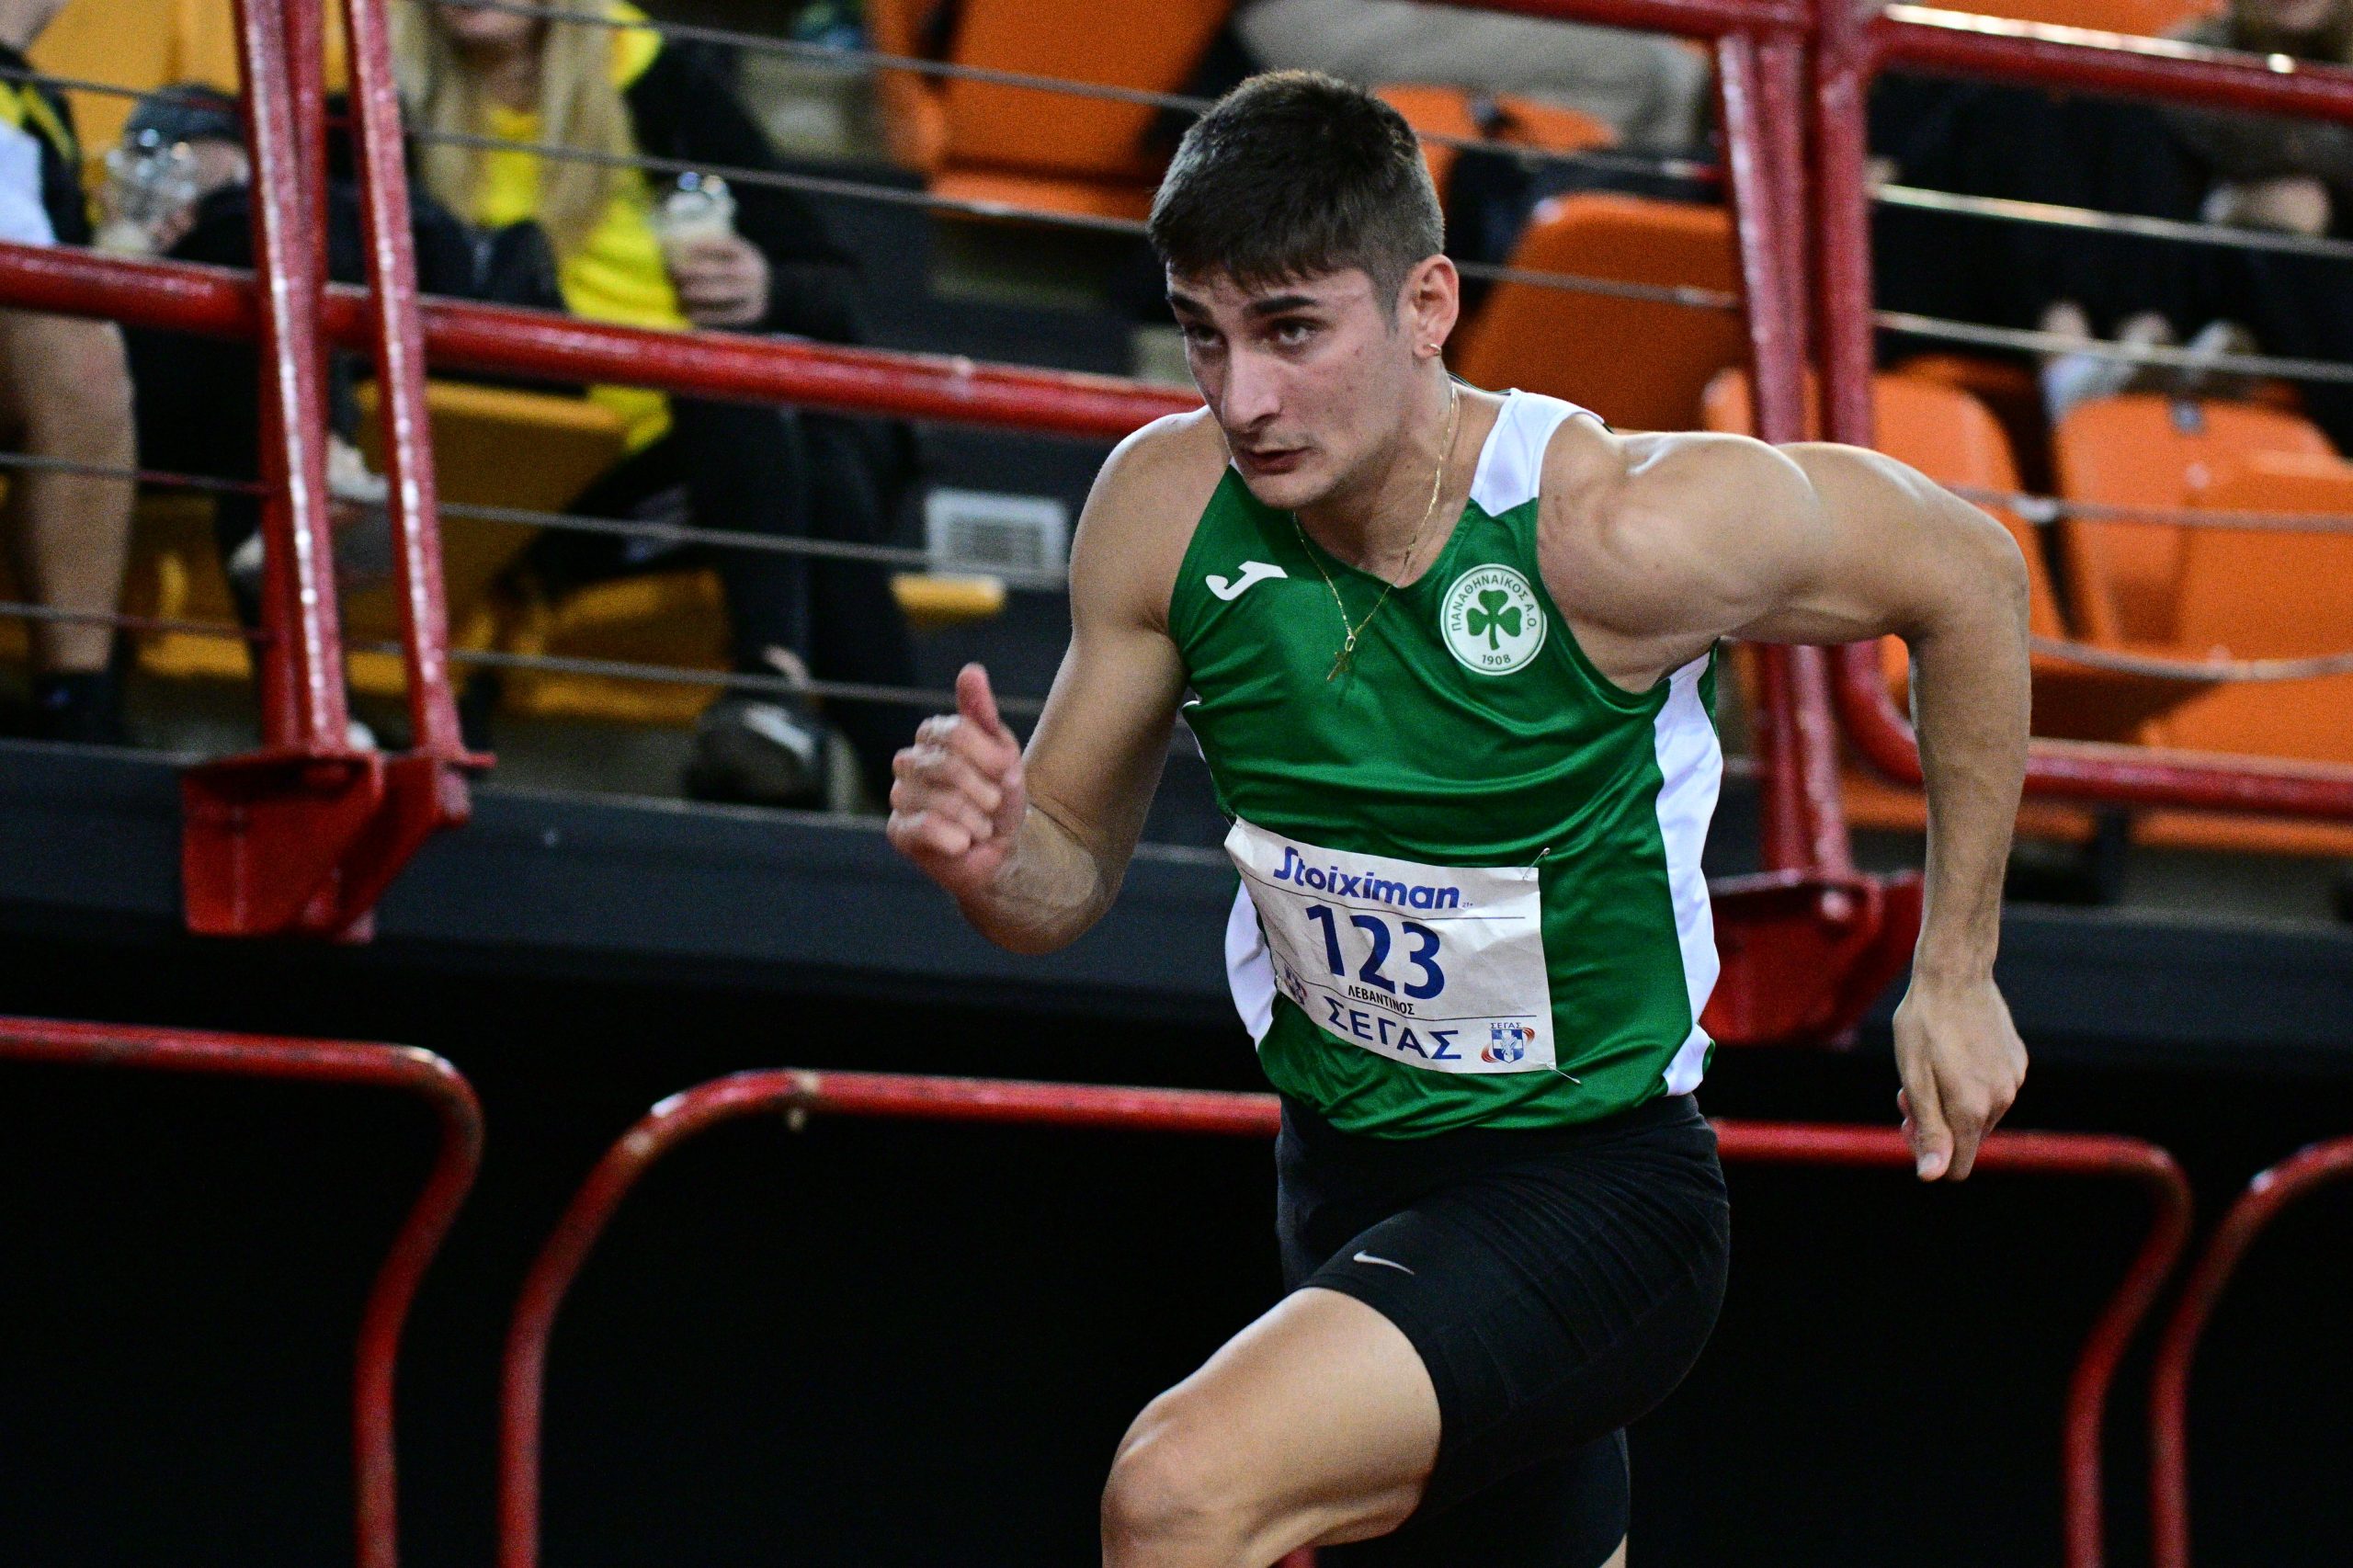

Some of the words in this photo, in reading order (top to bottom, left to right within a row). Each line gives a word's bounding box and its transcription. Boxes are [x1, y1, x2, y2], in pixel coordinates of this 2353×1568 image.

[1482, 653, 1511, 665] 1908
[1273, 846, 1460, 910] Stoiximan
[1306, 904, 1445, 1000] 123
[1324, 996, 1462, 1060] ΣΕΓΑΣ
[1348, 985, 1415, 1016] ΛΕΒΑΝΤΙΝΟΣ
